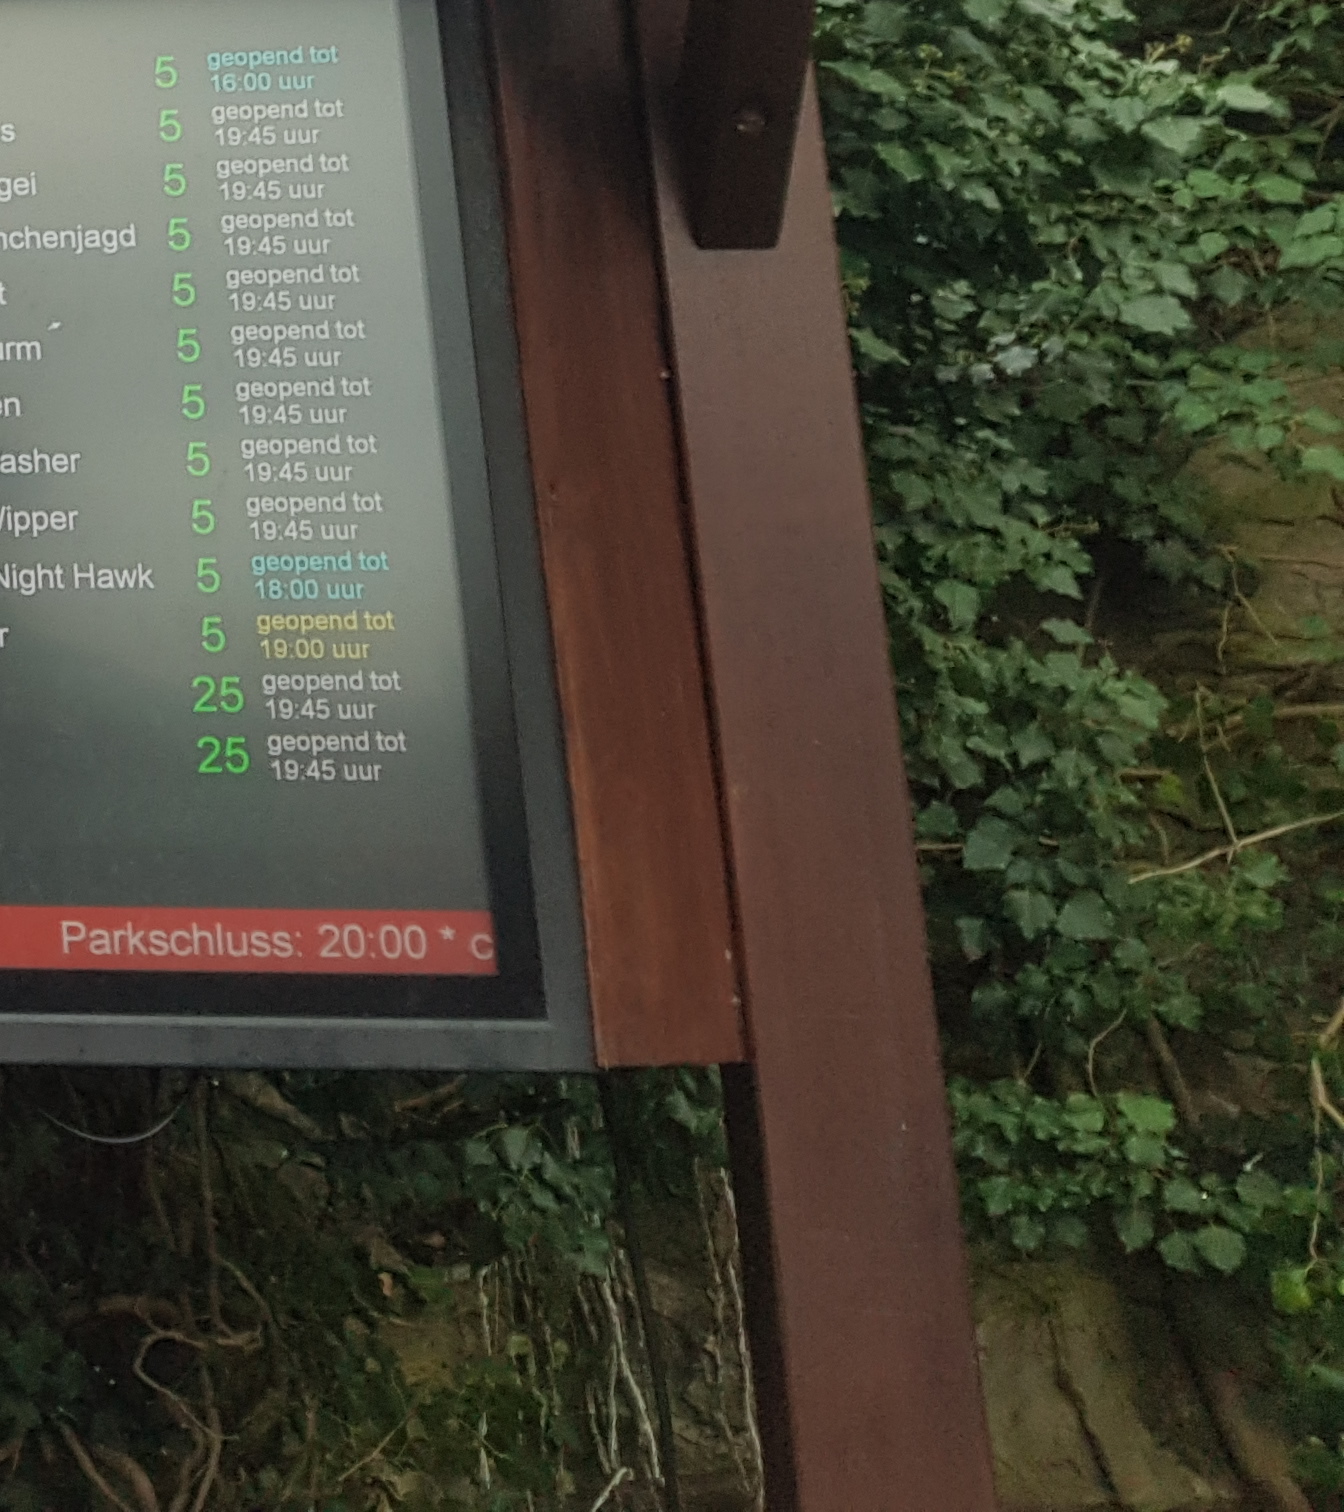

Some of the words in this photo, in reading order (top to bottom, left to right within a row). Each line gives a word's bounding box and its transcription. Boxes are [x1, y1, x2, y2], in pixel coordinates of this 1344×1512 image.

[74, 563, 154, 588] Hawk
[192, 676, 243, 713] 25
[197, 736, 249, 773] 25
[61, 921, 302, 957] Parkschluss:
[319, 924, 426, 958] 20:00
